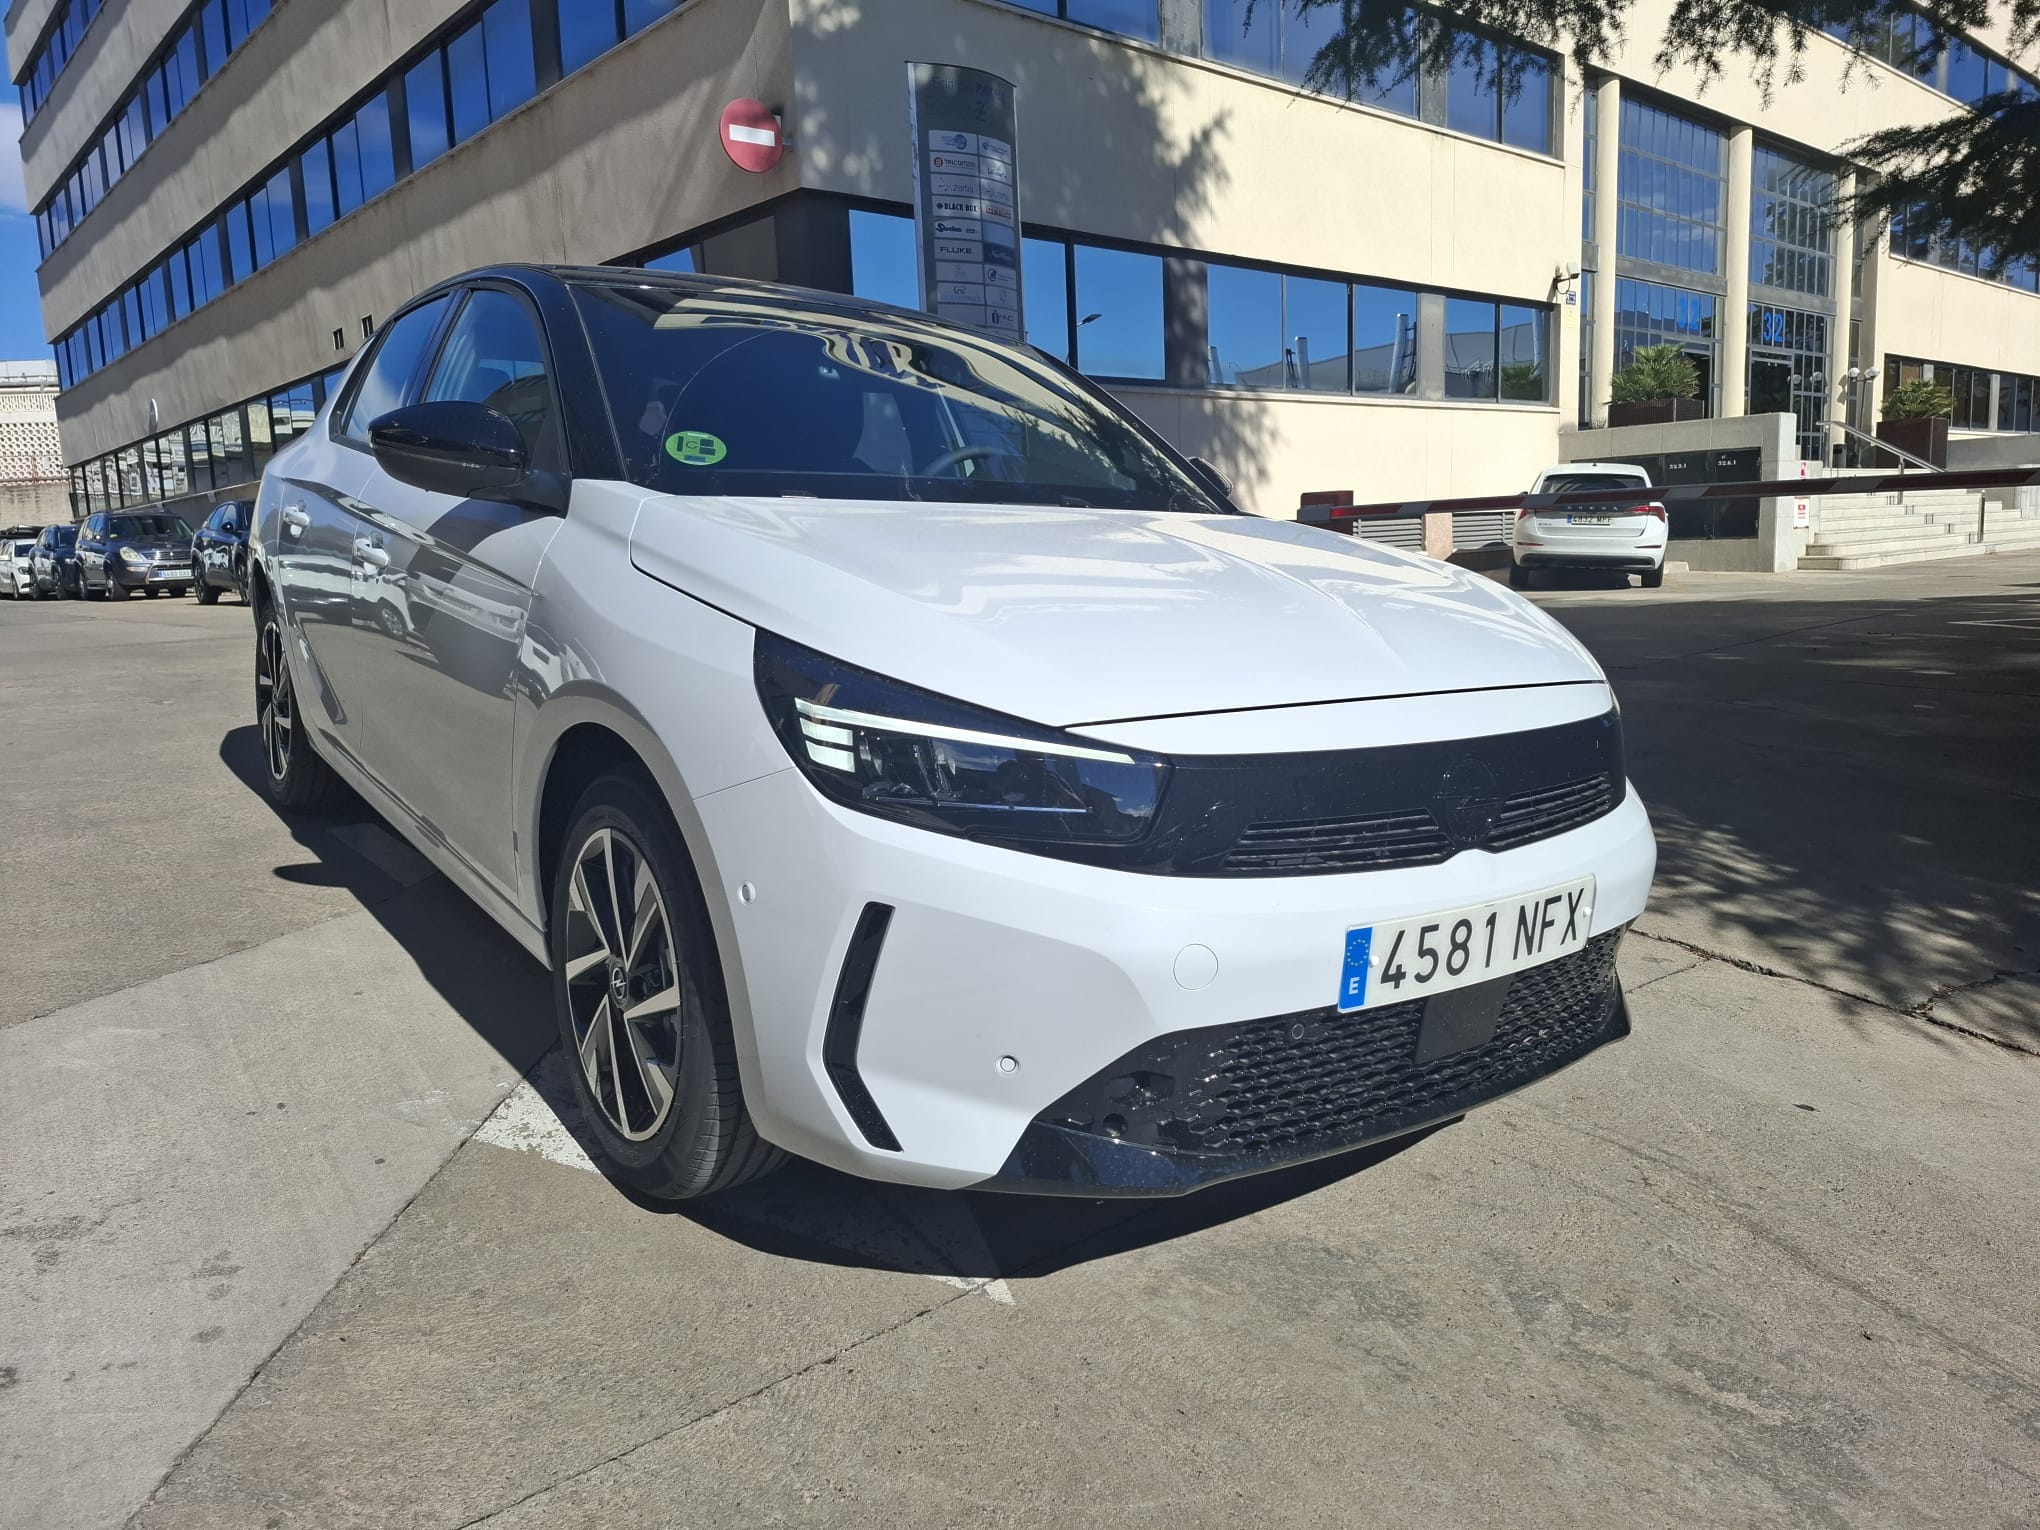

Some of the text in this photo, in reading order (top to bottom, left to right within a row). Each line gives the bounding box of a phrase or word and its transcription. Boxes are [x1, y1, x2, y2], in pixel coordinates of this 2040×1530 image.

[944, 202, 963, 211] BLACK
[940, 246, 972, 255] FLUKE
[1763, 312, 1784, 343] 32
[1380, 887, 1584, 990] 4581 NFX
[1349, 977, 1360, 994] E
